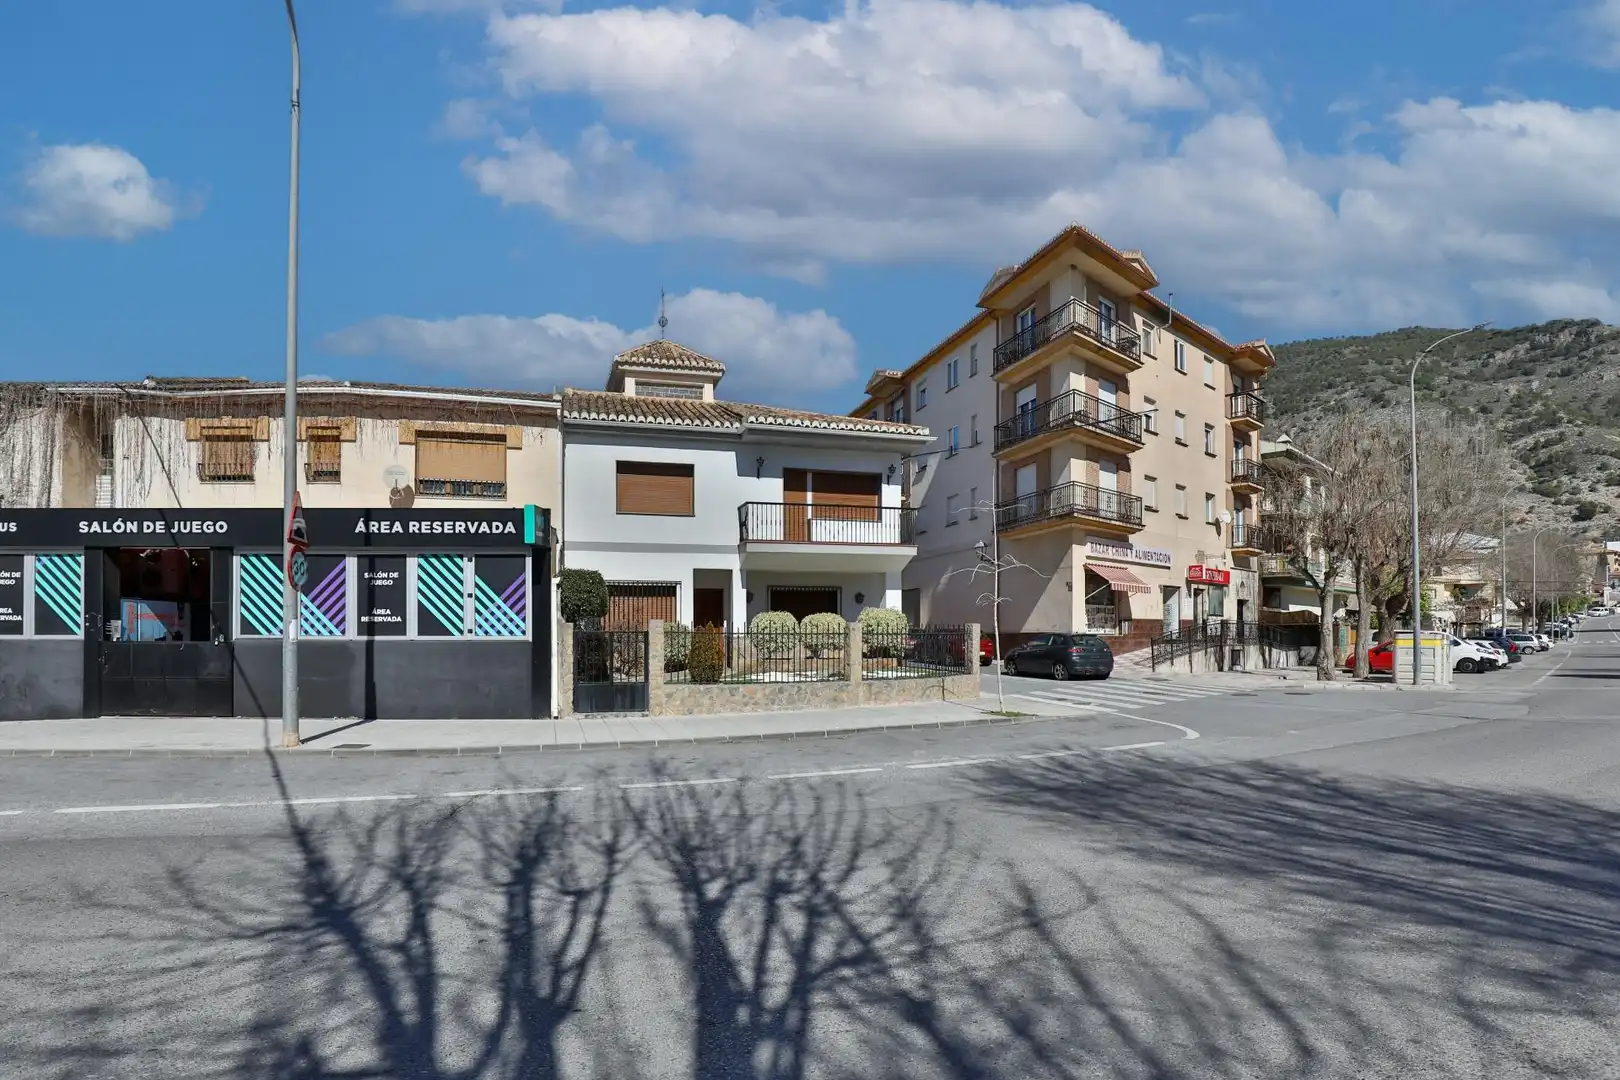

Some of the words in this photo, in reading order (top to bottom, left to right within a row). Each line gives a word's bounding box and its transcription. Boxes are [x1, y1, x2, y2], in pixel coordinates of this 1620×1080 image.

[78, 518, 138, 533] SALÓN
[142, 521, 166, 533] DE
[170, 521, 228, 533] JUEGO
[354, 518, 404, 533] ÁREA
[408, 521, 517, 534] RESERVADA
[293, 561, 305, 575] 30
[364, 571, 388, 579] SALÓN
[372, 607, 391, 615] ÁREA
